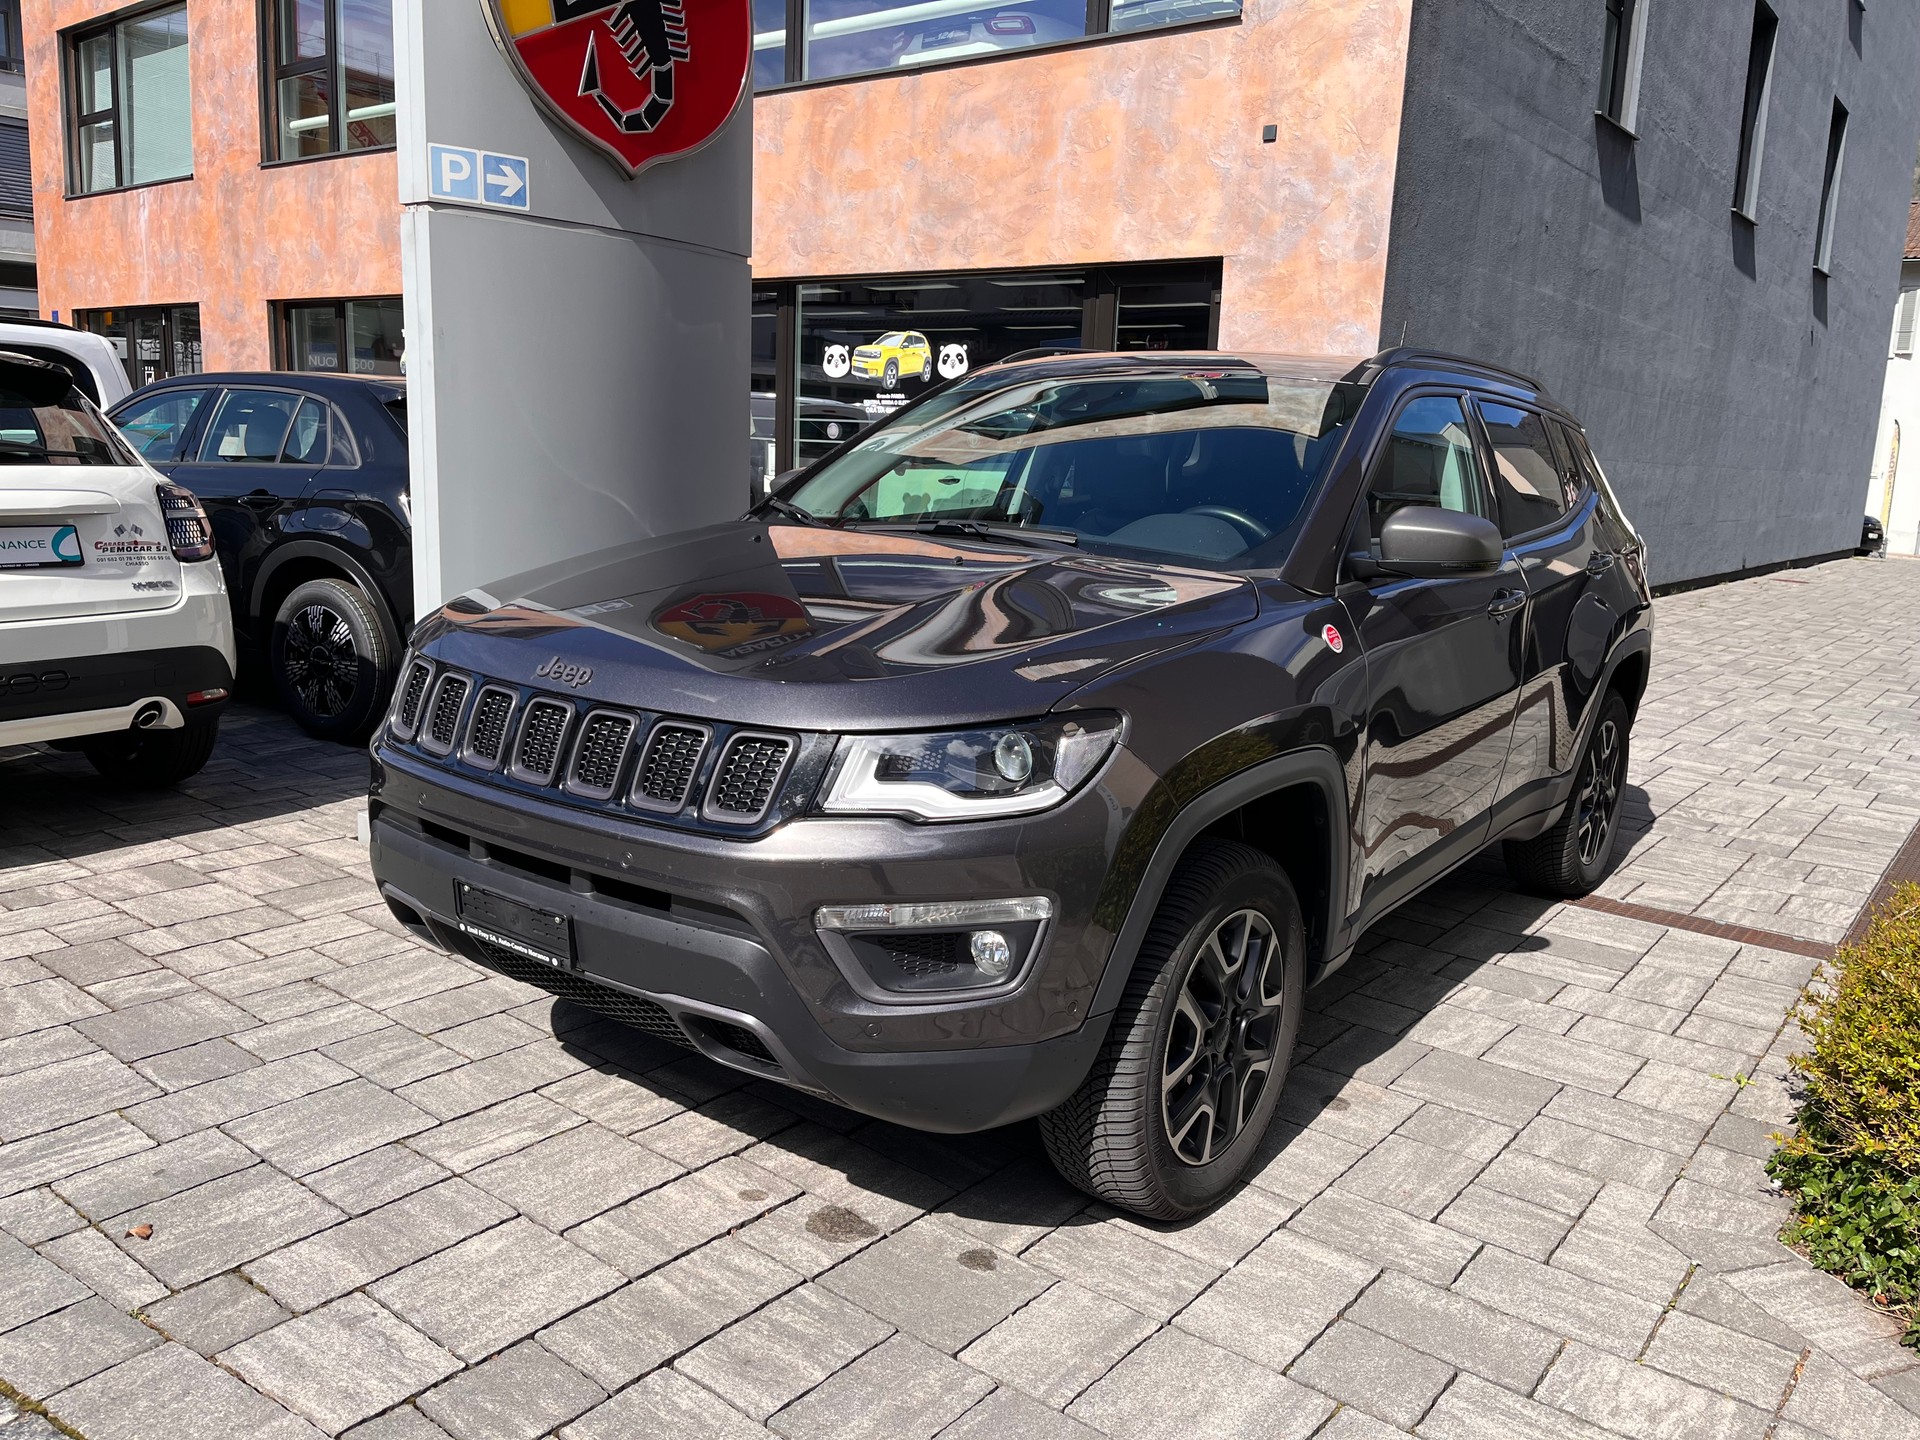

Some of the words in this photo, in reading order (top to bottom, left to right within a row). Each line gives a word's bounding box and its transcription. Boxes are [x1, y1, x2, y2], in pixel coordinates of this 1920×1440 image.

[441, 152, 471, 192] P
[102, 545, 152, 553] PEMOCAR
[536, 655, 593, 689] Jeep
